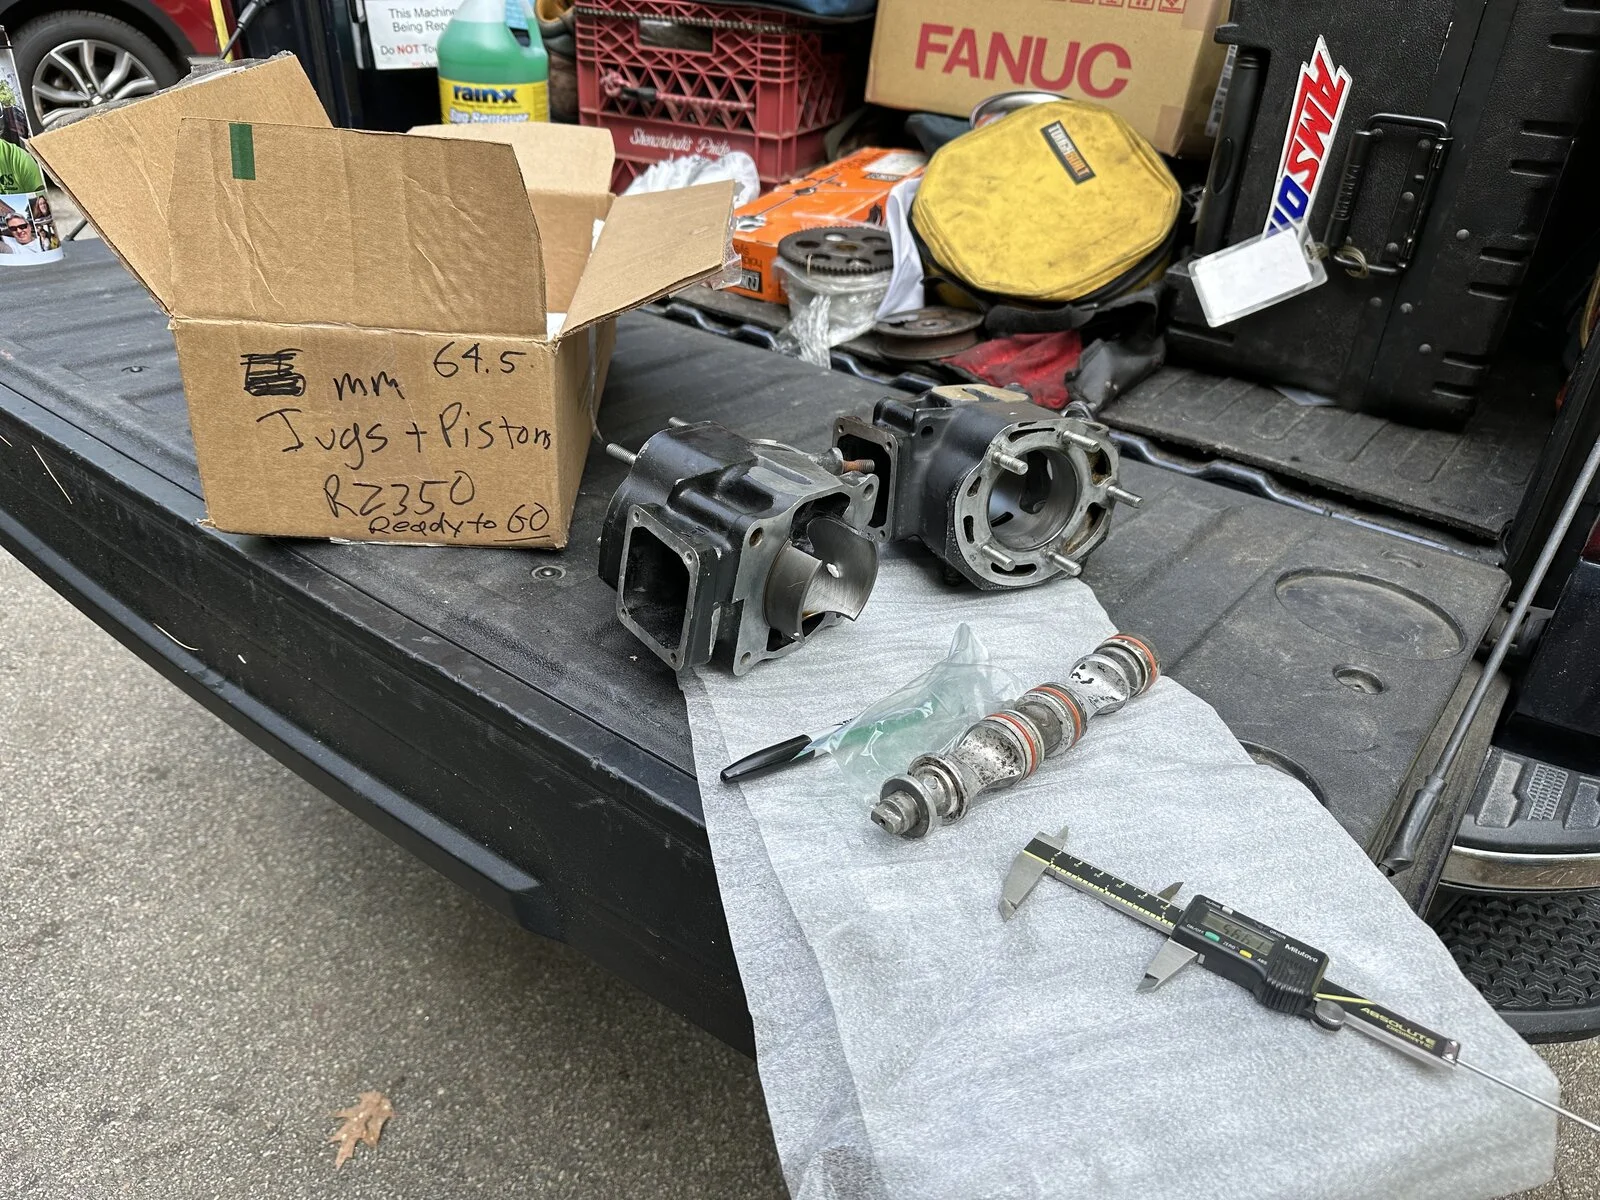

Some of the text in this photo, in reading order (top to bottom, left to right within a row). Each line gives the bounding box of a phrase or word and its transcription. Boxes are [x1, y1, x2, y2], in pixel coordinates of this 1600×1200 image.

[388, 7, 411, 18] This
[392, 21, 424, 34] Being
[380, 45, 395, 55] Do
[397, 44, 419, 54] NOT
[915, 22, 1132, 100] FANUC
[333, 371, 406, 401] mm
[433, 341, 527, 378] 64.5
[256, 408, 389, 470] Jugs
[405, 422, 428, 453] +
[323, 470, 476, 518] RZ350
[368, 502, 550, 538] Ready to GO
[1222, 941, 1236, 950] ZERO
[1284, 943, 1319, 964] Mitutoyo
[1257, 957, 1268, 966] ABS
[1360, 1007, 1437, 1047] ABSOLUTE
